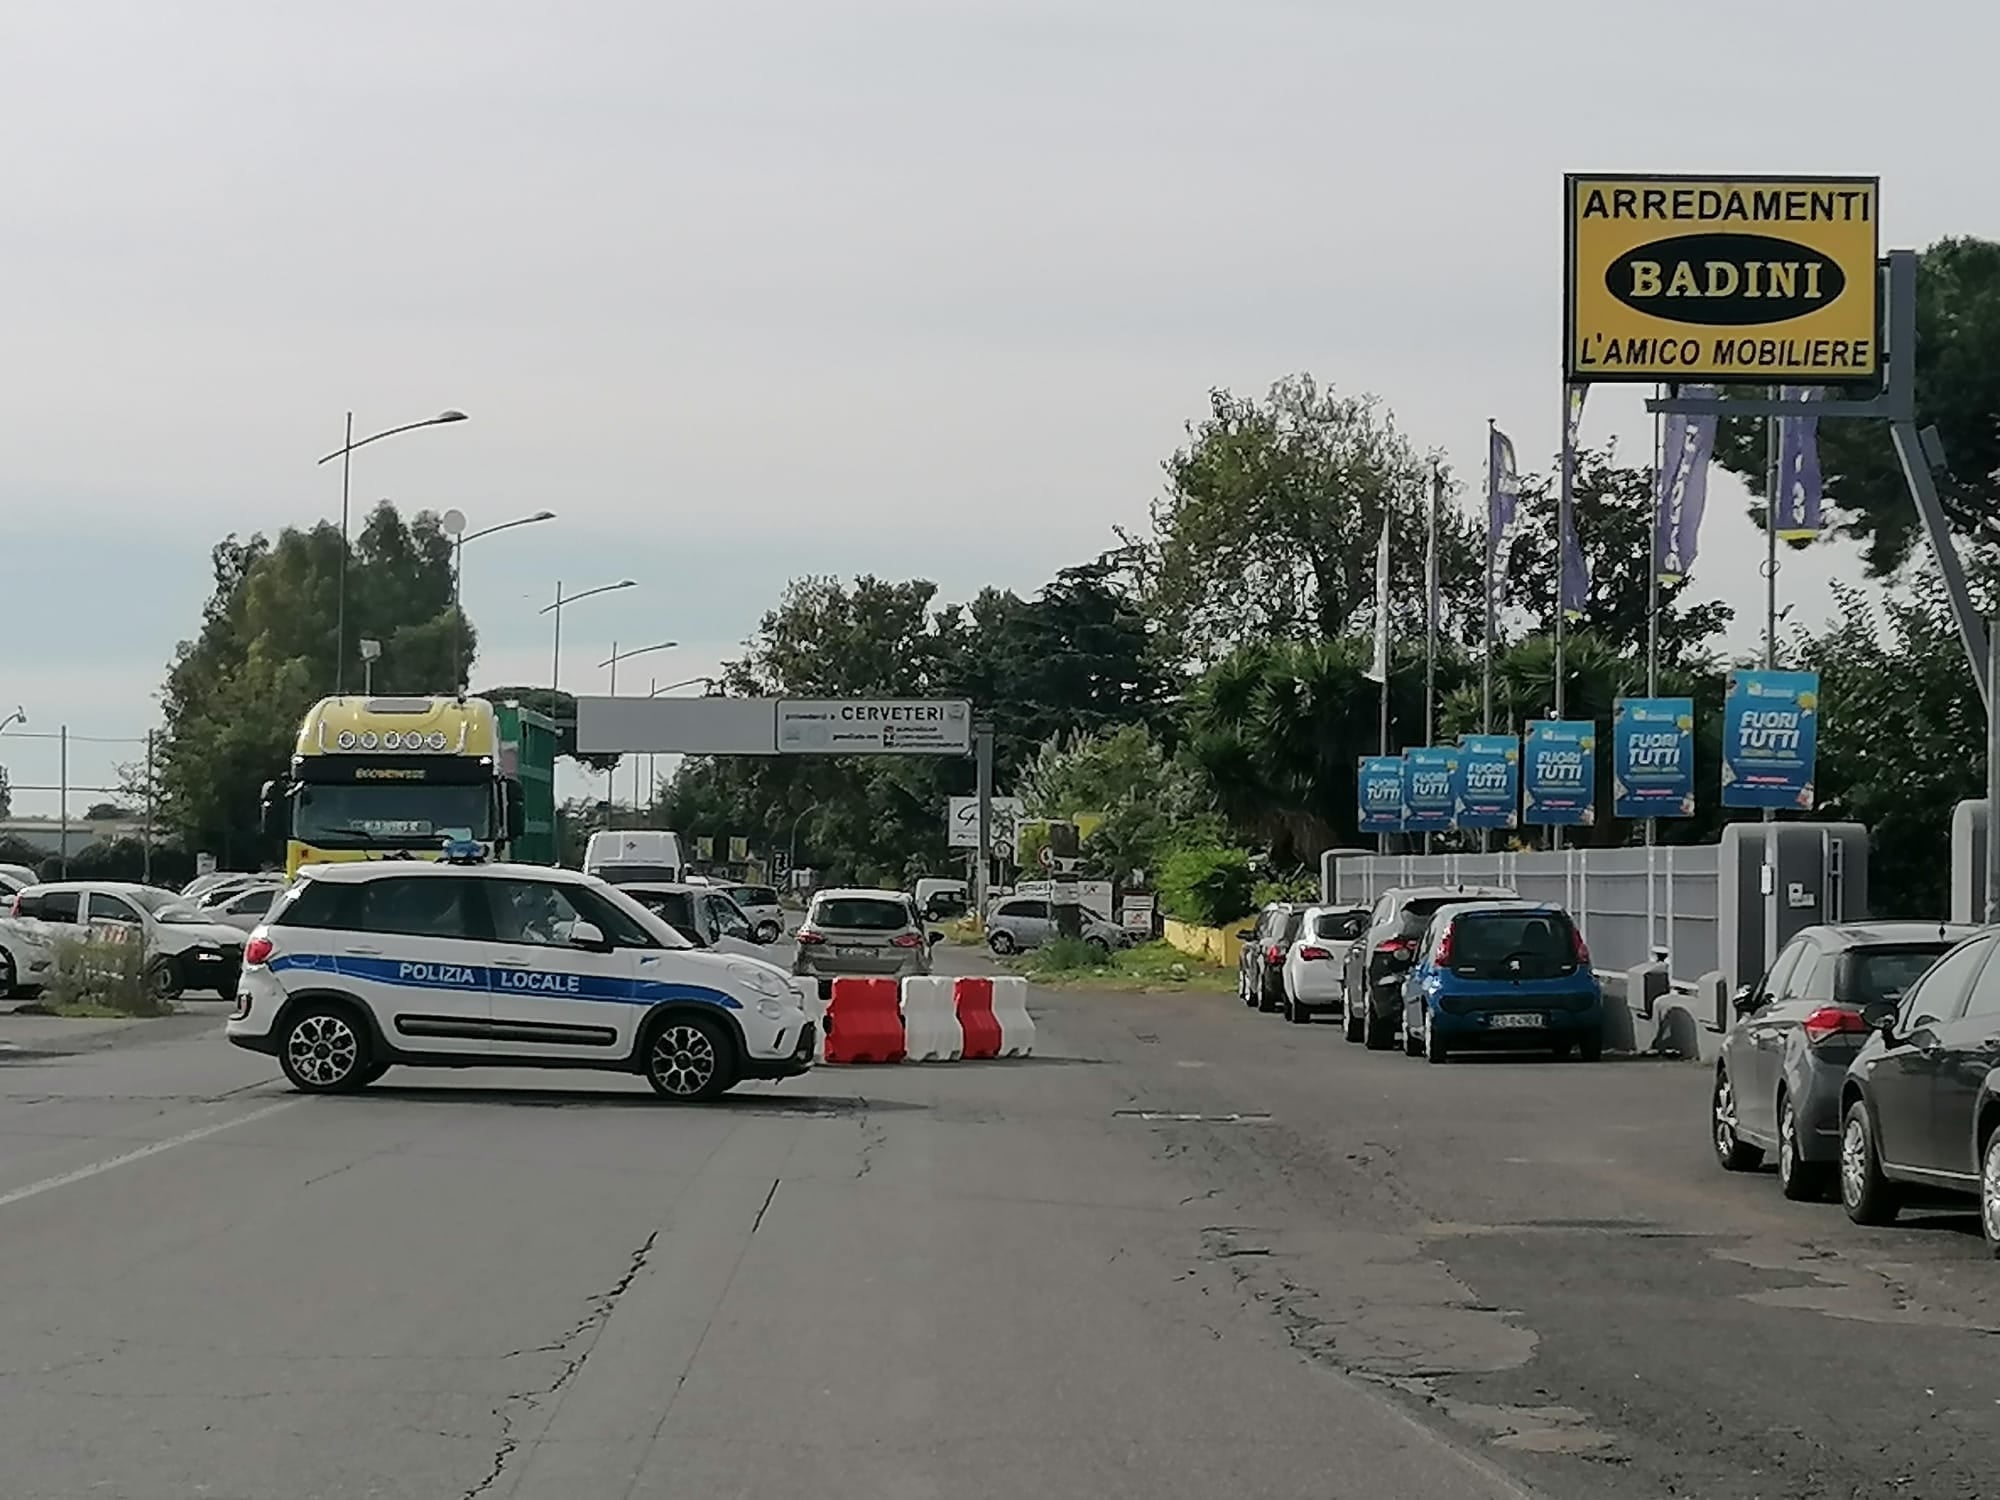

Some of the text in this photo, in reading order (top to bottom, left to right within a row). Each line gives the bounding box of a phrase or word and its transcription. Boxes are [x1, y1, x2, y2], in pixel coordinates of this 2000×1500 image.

[1582, 189, 1870, 221] ARREDAMENTI
[1629, 261, 1823, 298] BADINI
[1580, 333, 1870, 367] L'AMICO MOBILIERE
[841, 706, 944, 721] CERVETERI
[1740, 710, 1799, 729] FUORI
[1628, 733, 1680, 748] FUORI
[1739, 728, 1801, 749] TUTTI
[1537, 751, 1581, 764] FUORI
[1628, 748, 1681, 766] TUTTI
[1467, 762, 1505, 774] FUORI
[1536, 764, 1583, 780] TUTTI
[1466, 774, 1508, 788] TUTTI
[399, 963, 580, 992] POLIZIA LOCALE
